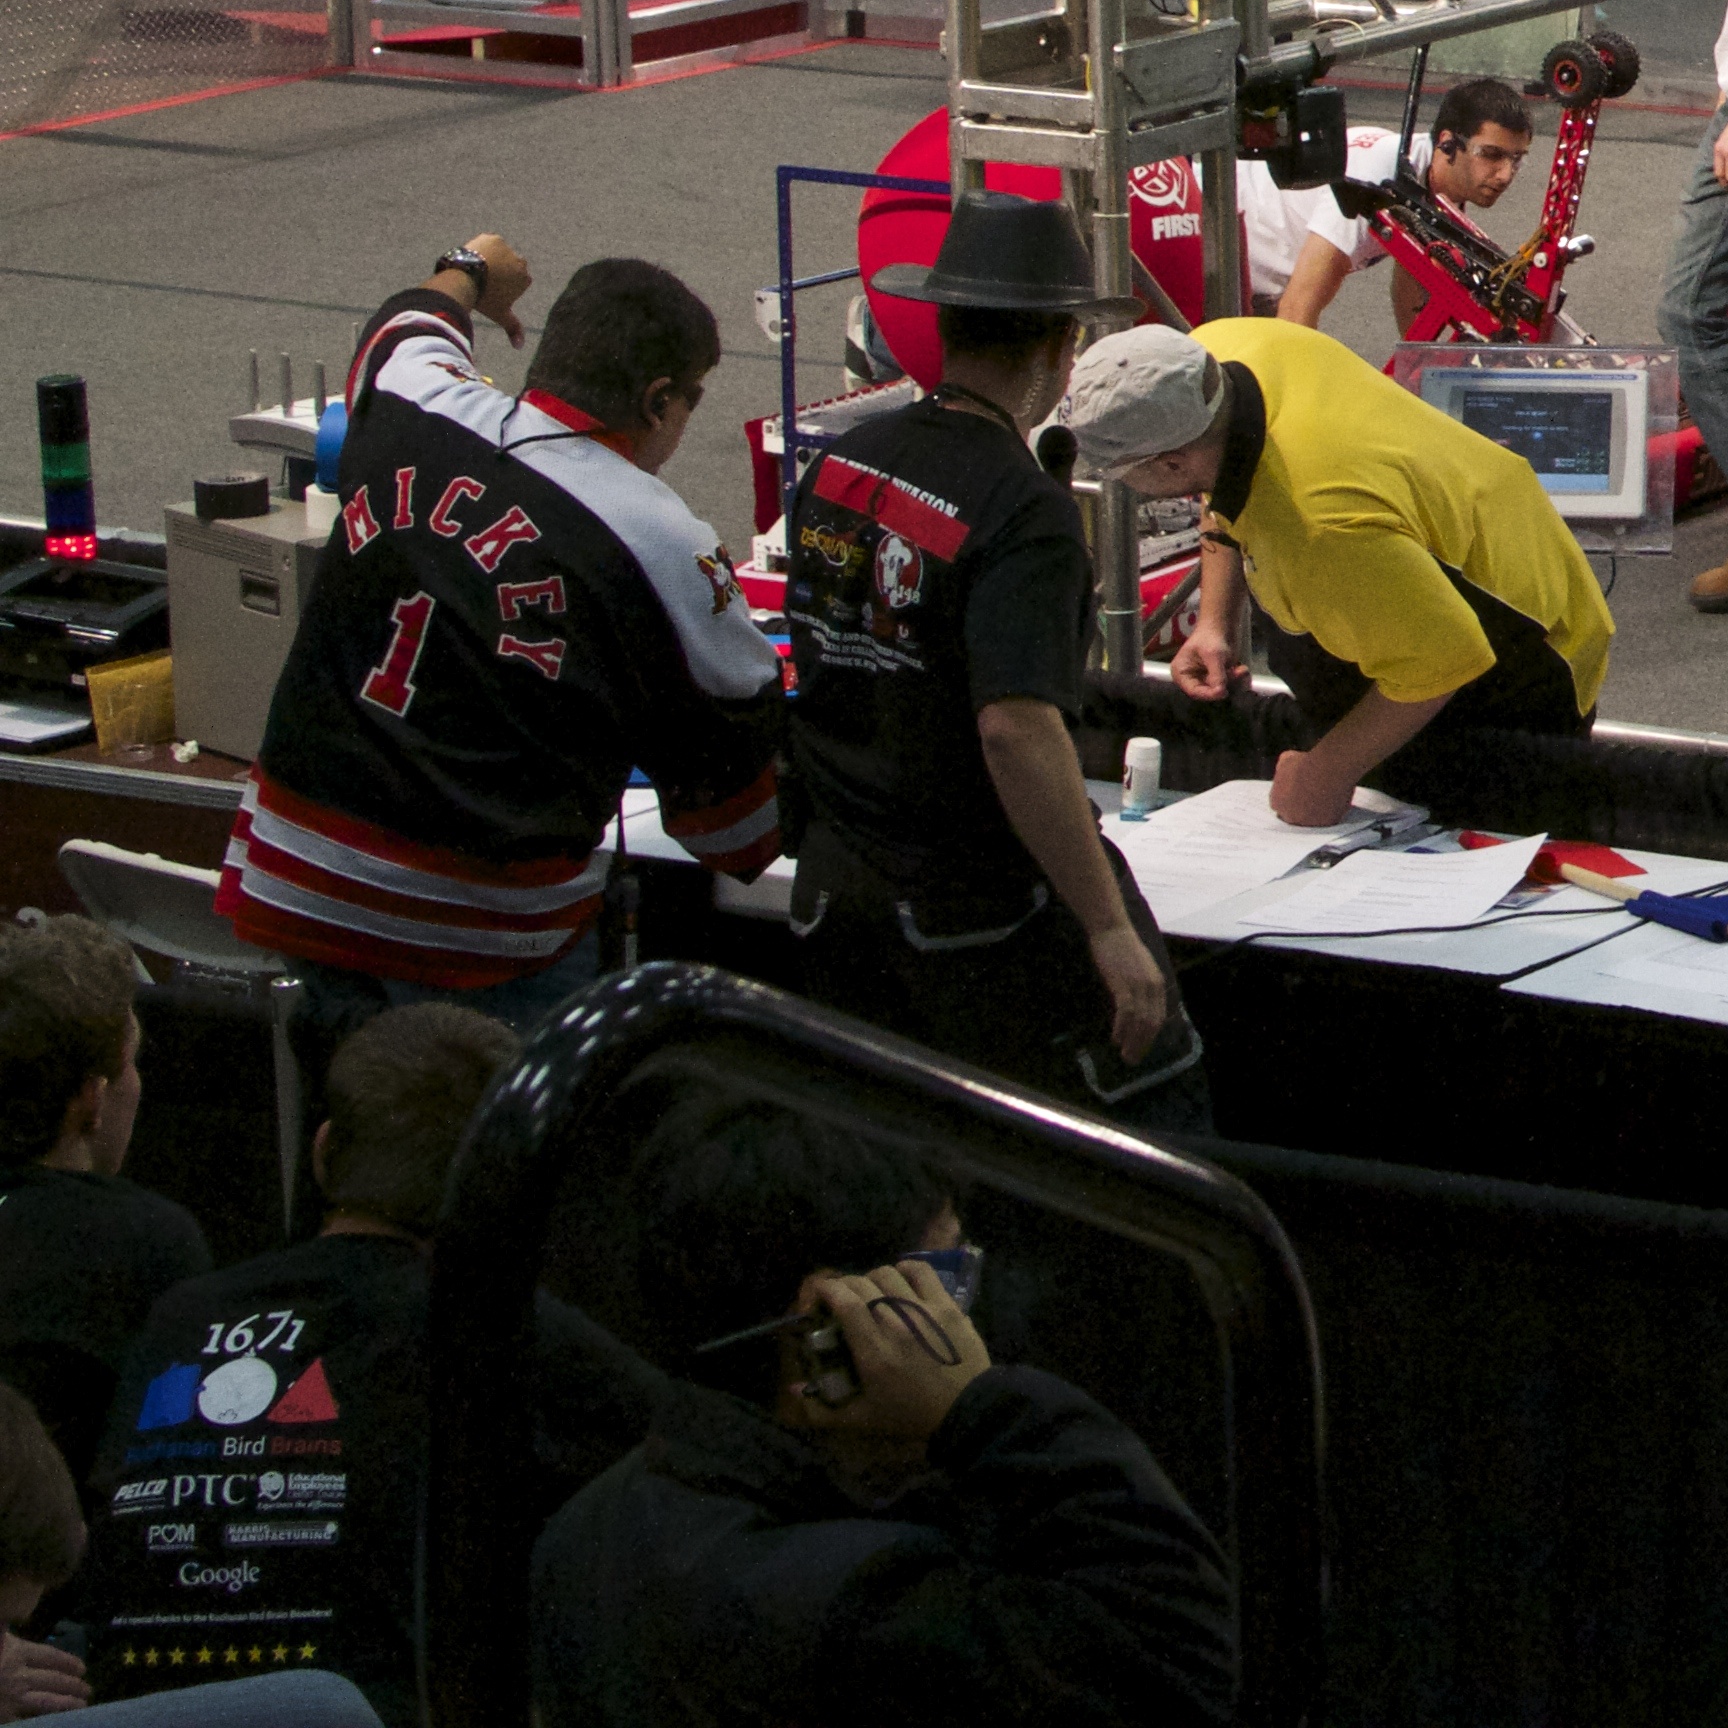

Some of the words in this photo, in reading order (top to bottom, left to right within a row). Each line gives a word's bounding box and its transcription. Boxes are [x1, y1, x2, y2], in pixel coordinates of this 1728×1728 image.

[1151, 212, 1201, 241] FIRST
[342, 466, 567, 681] MICKEY
[360, 590, 437, 718] 1
[201, 1309, 306, 1355] 1671
[222, 1435, 267, 1457] Bird
[270, 1437, 343, 1457] Brains
[230, 1531, 333, 1543] MANUFACTURING
[179, 1560, 261, 1593] Google
